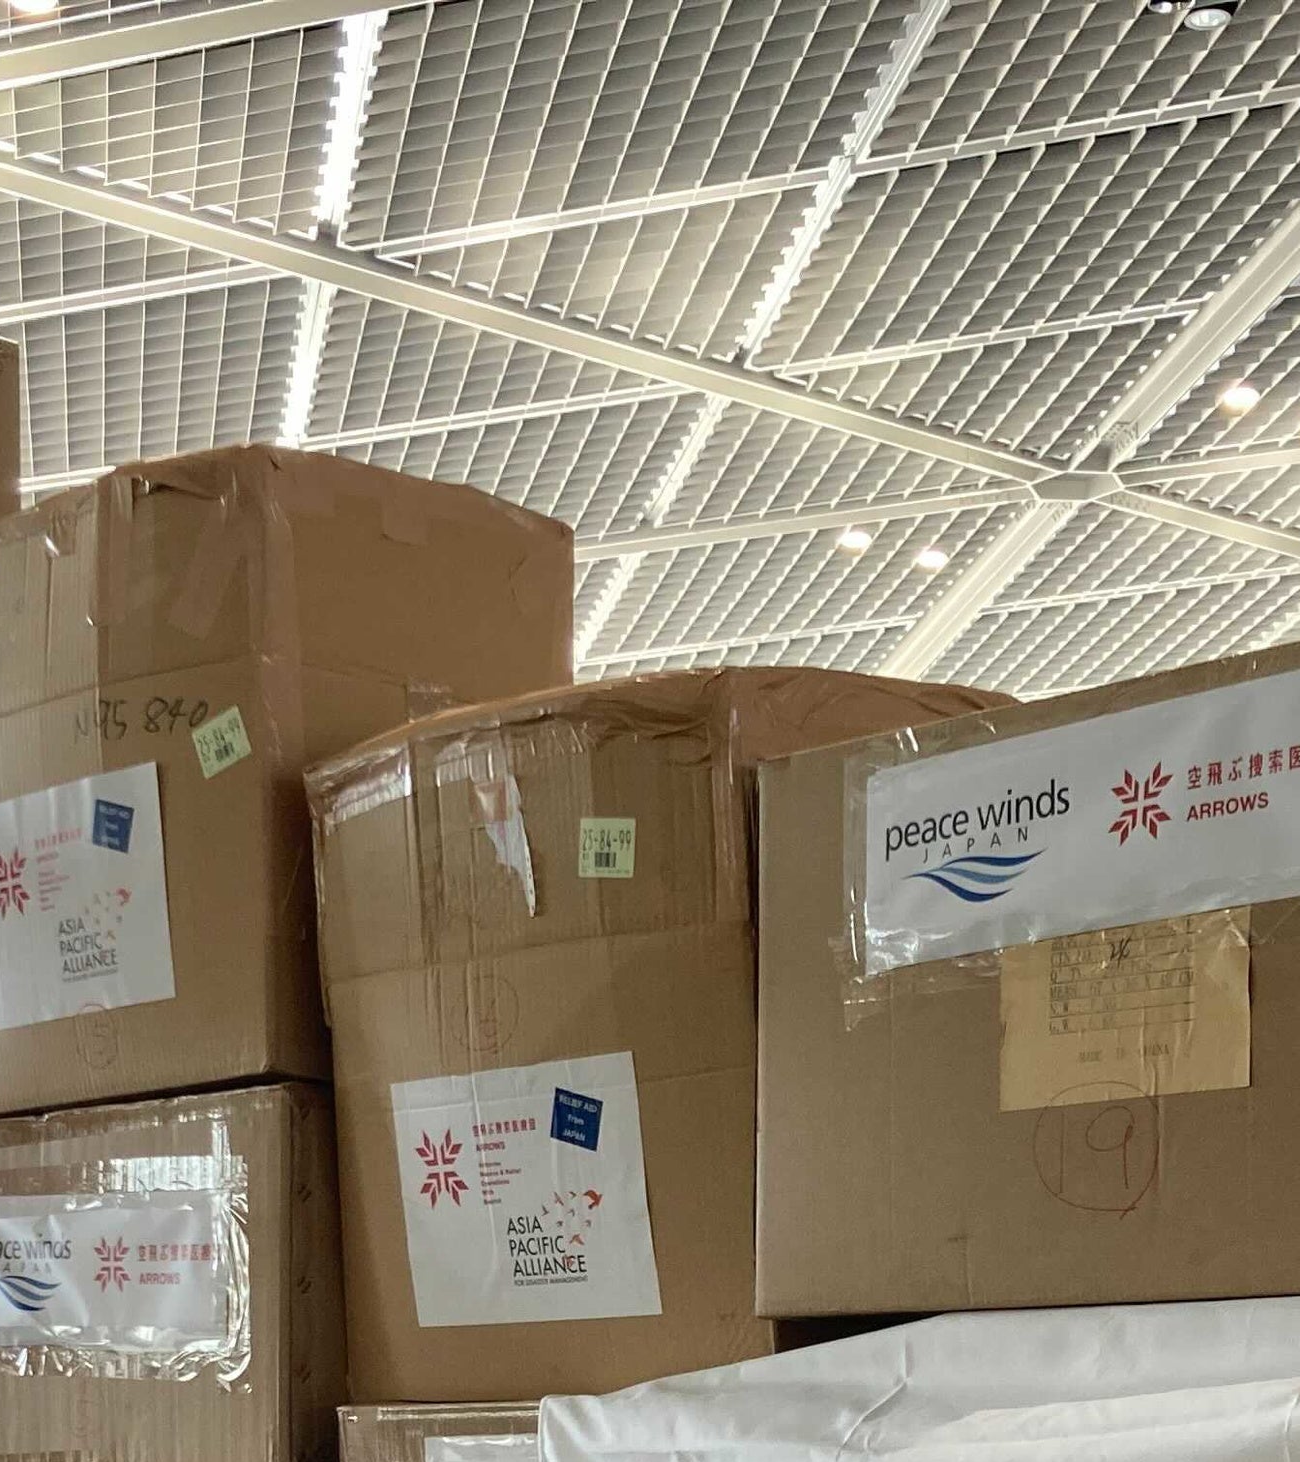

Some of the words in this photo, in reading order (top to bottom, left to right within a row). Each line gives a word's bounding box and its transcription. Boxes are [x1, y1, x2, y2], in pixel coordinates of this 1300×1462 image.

[144, 696, 208, 735] 840
[1186, 791, 1270, 822] ARROWS
[885, 809, 970, 862] peace
[977, 778, 1070, 831] winds
[922, 827, 1029, 864] JAPAN
[59, 917, 86, 935] ASIA
[507, 1213, 544, 1236] ASIA
[508, 1235, 566, 1258] PACIFIC
[513, 1254, 588, 1278] ALLIANCE
[139, 1272, 180, 1285] ARROWS
